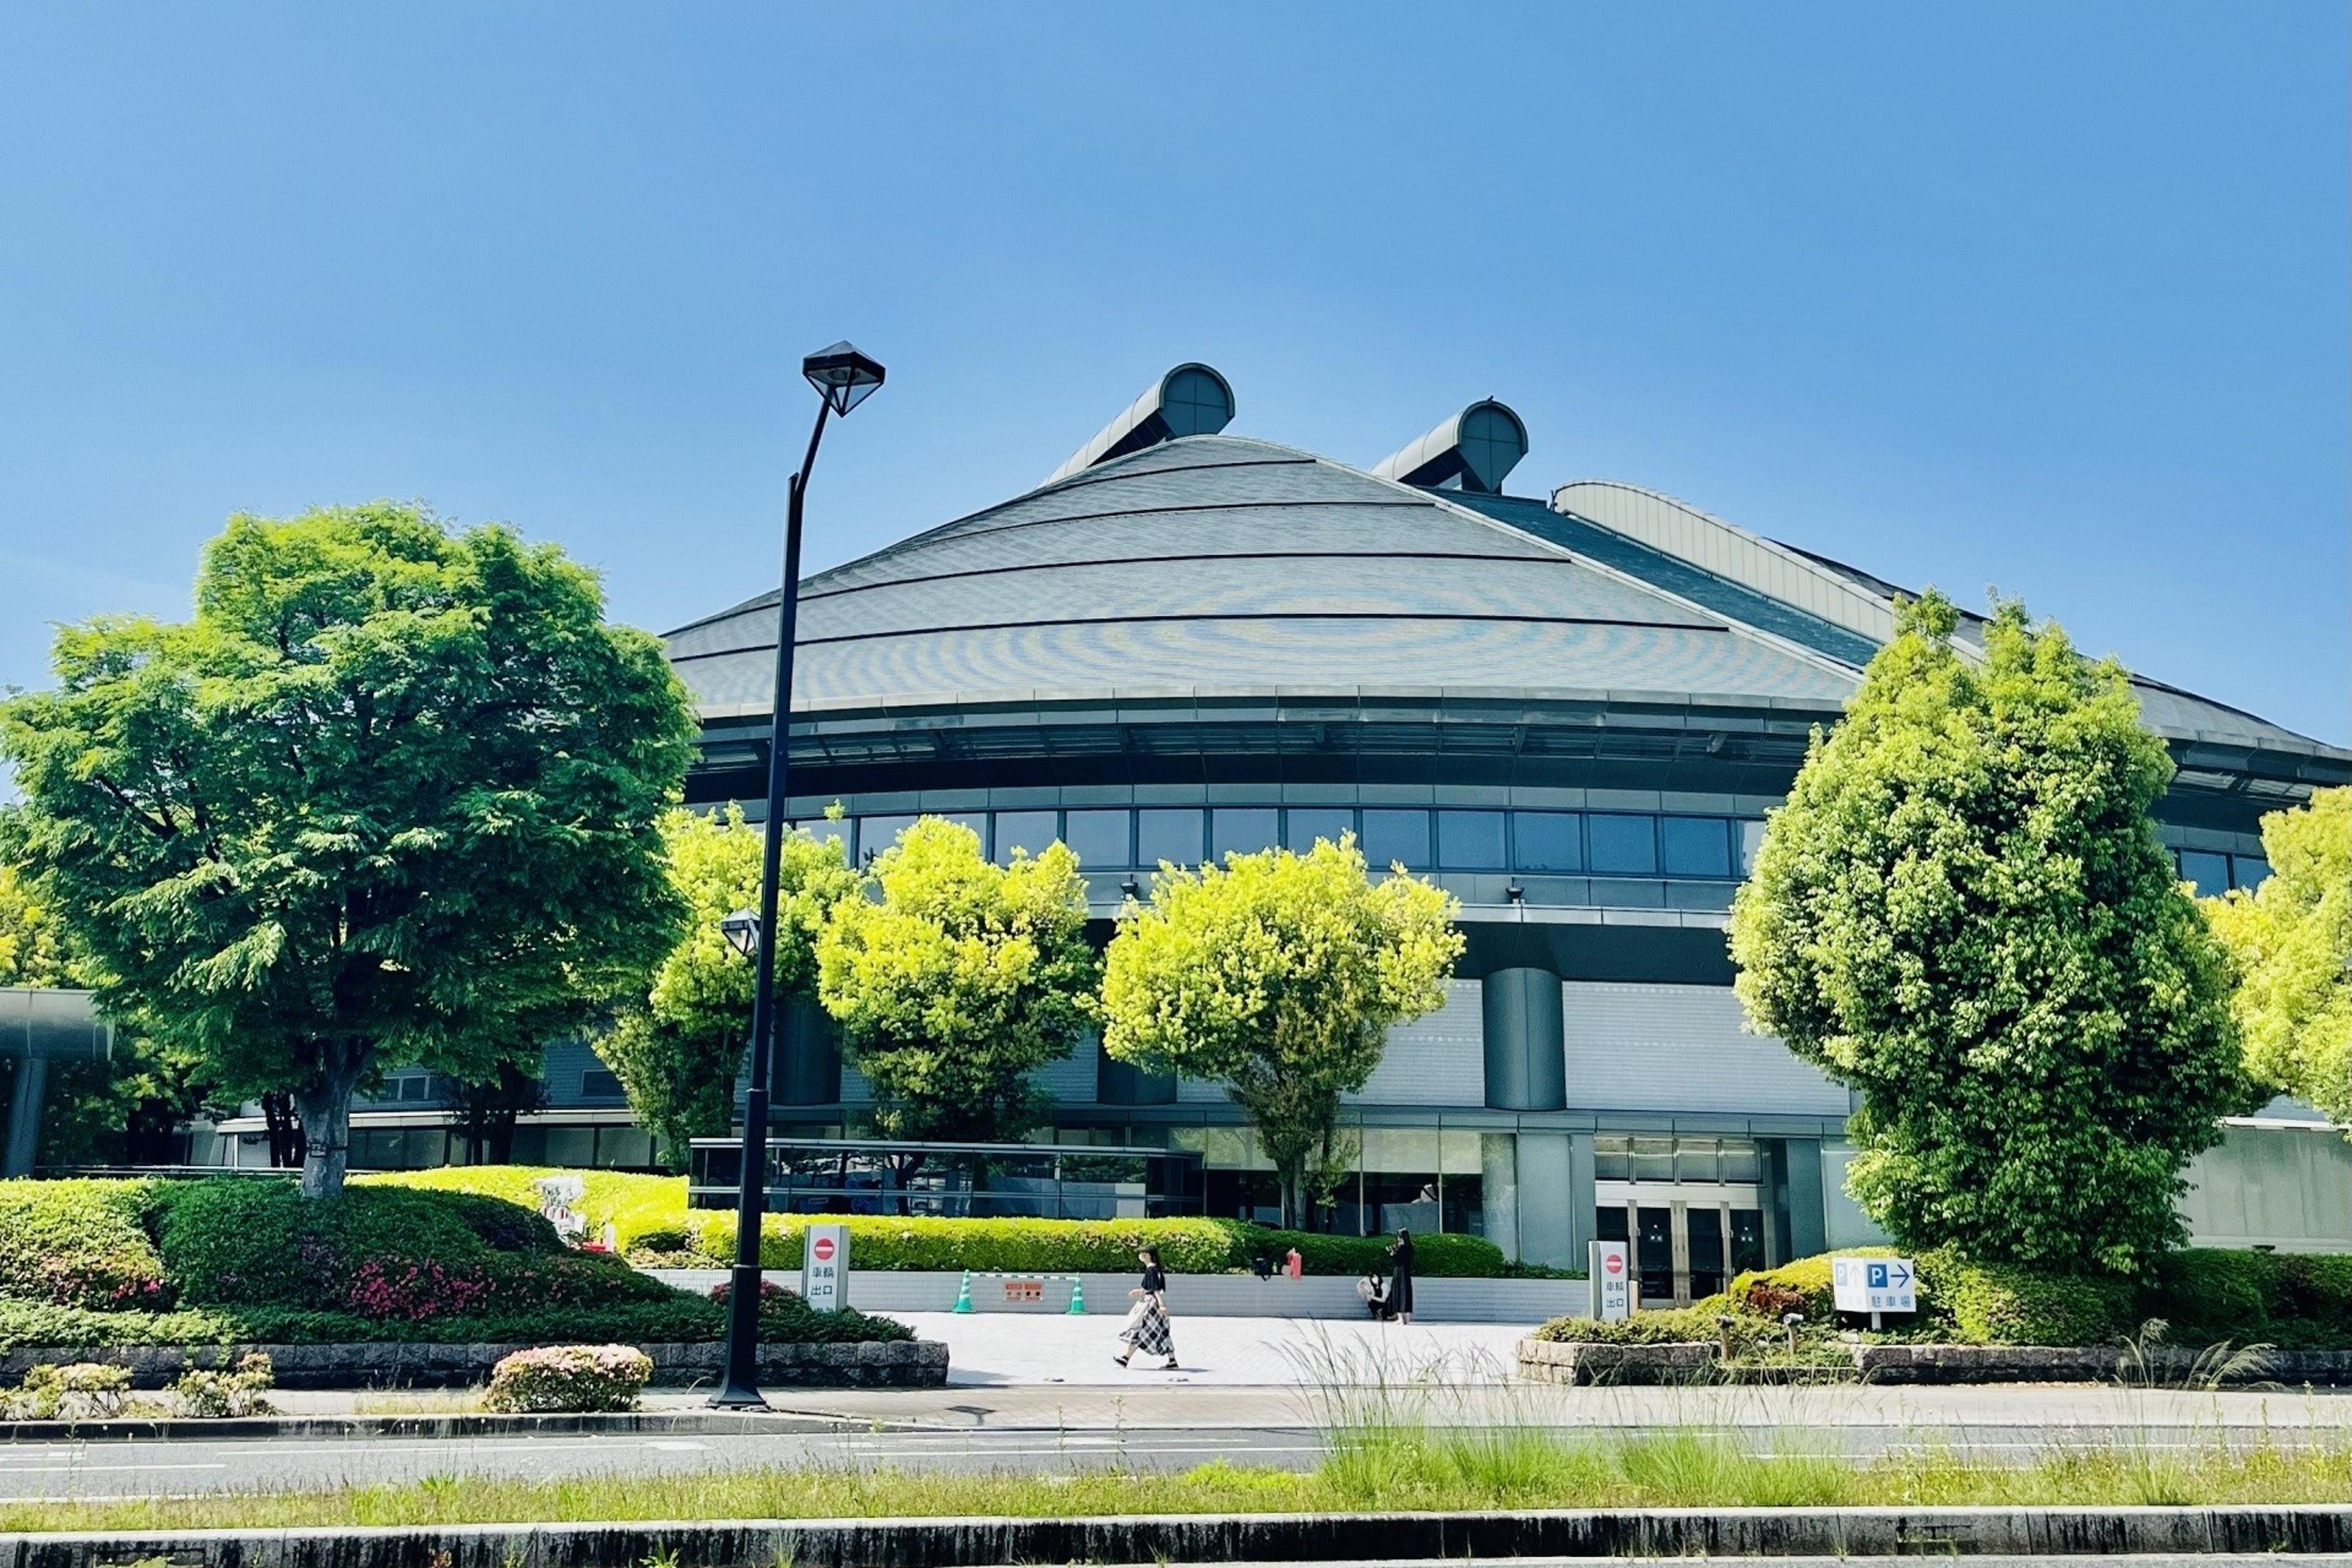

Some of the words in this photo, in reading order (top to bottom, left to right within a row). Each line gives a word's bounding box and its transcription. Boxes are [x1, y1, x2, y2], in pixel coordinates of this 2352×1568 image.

[1837, 1266, 1845, 1283] P
[1871, 1267, 1883, 1285] P
[810, 1284, 832, 1295] 出口
[1607, 1298, 1624, 1308] 出口
[1871, 1295, 1911, 1308] 駐車場
